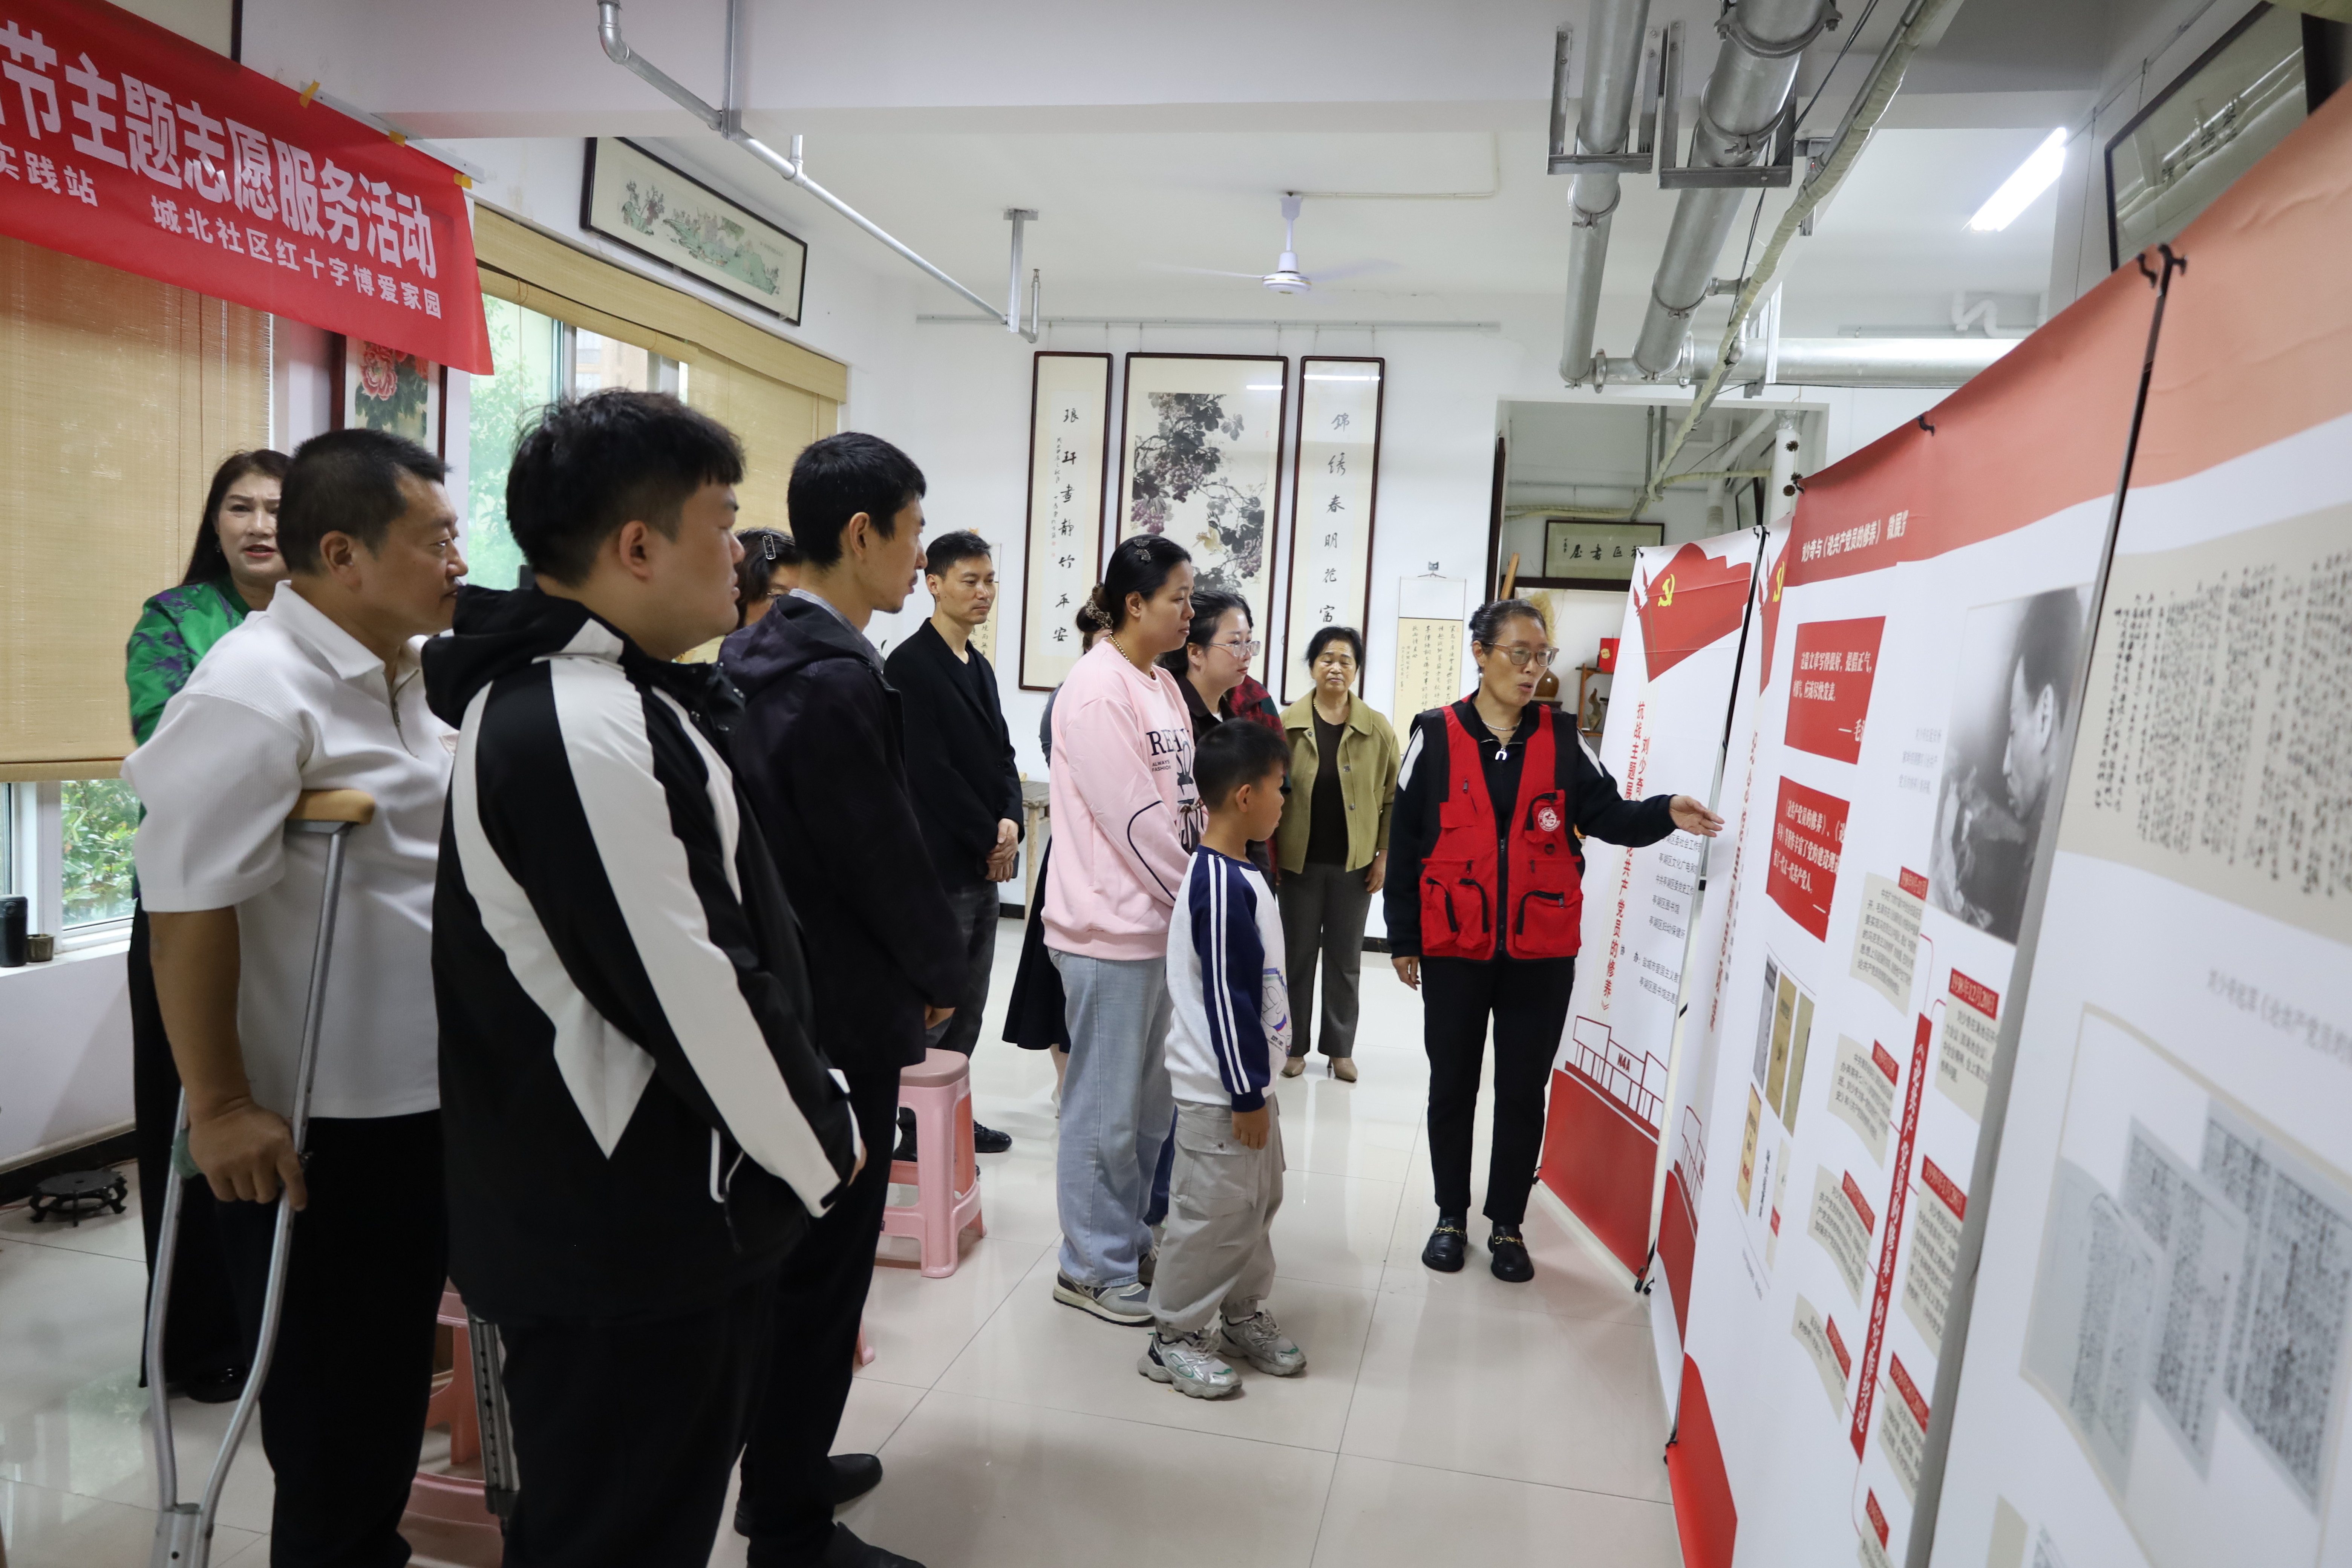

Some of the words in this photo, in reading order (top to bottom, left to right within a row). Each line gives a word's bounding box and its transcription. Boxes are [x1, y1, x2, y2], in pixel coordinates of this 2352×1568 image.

[0, 20, 436, 279] 节主题志愿服务活动
[151, 195, 442, 319] 城北社区红十字博爱家园
[1652, 894, 1680, 915] 亭湖区图书馆
